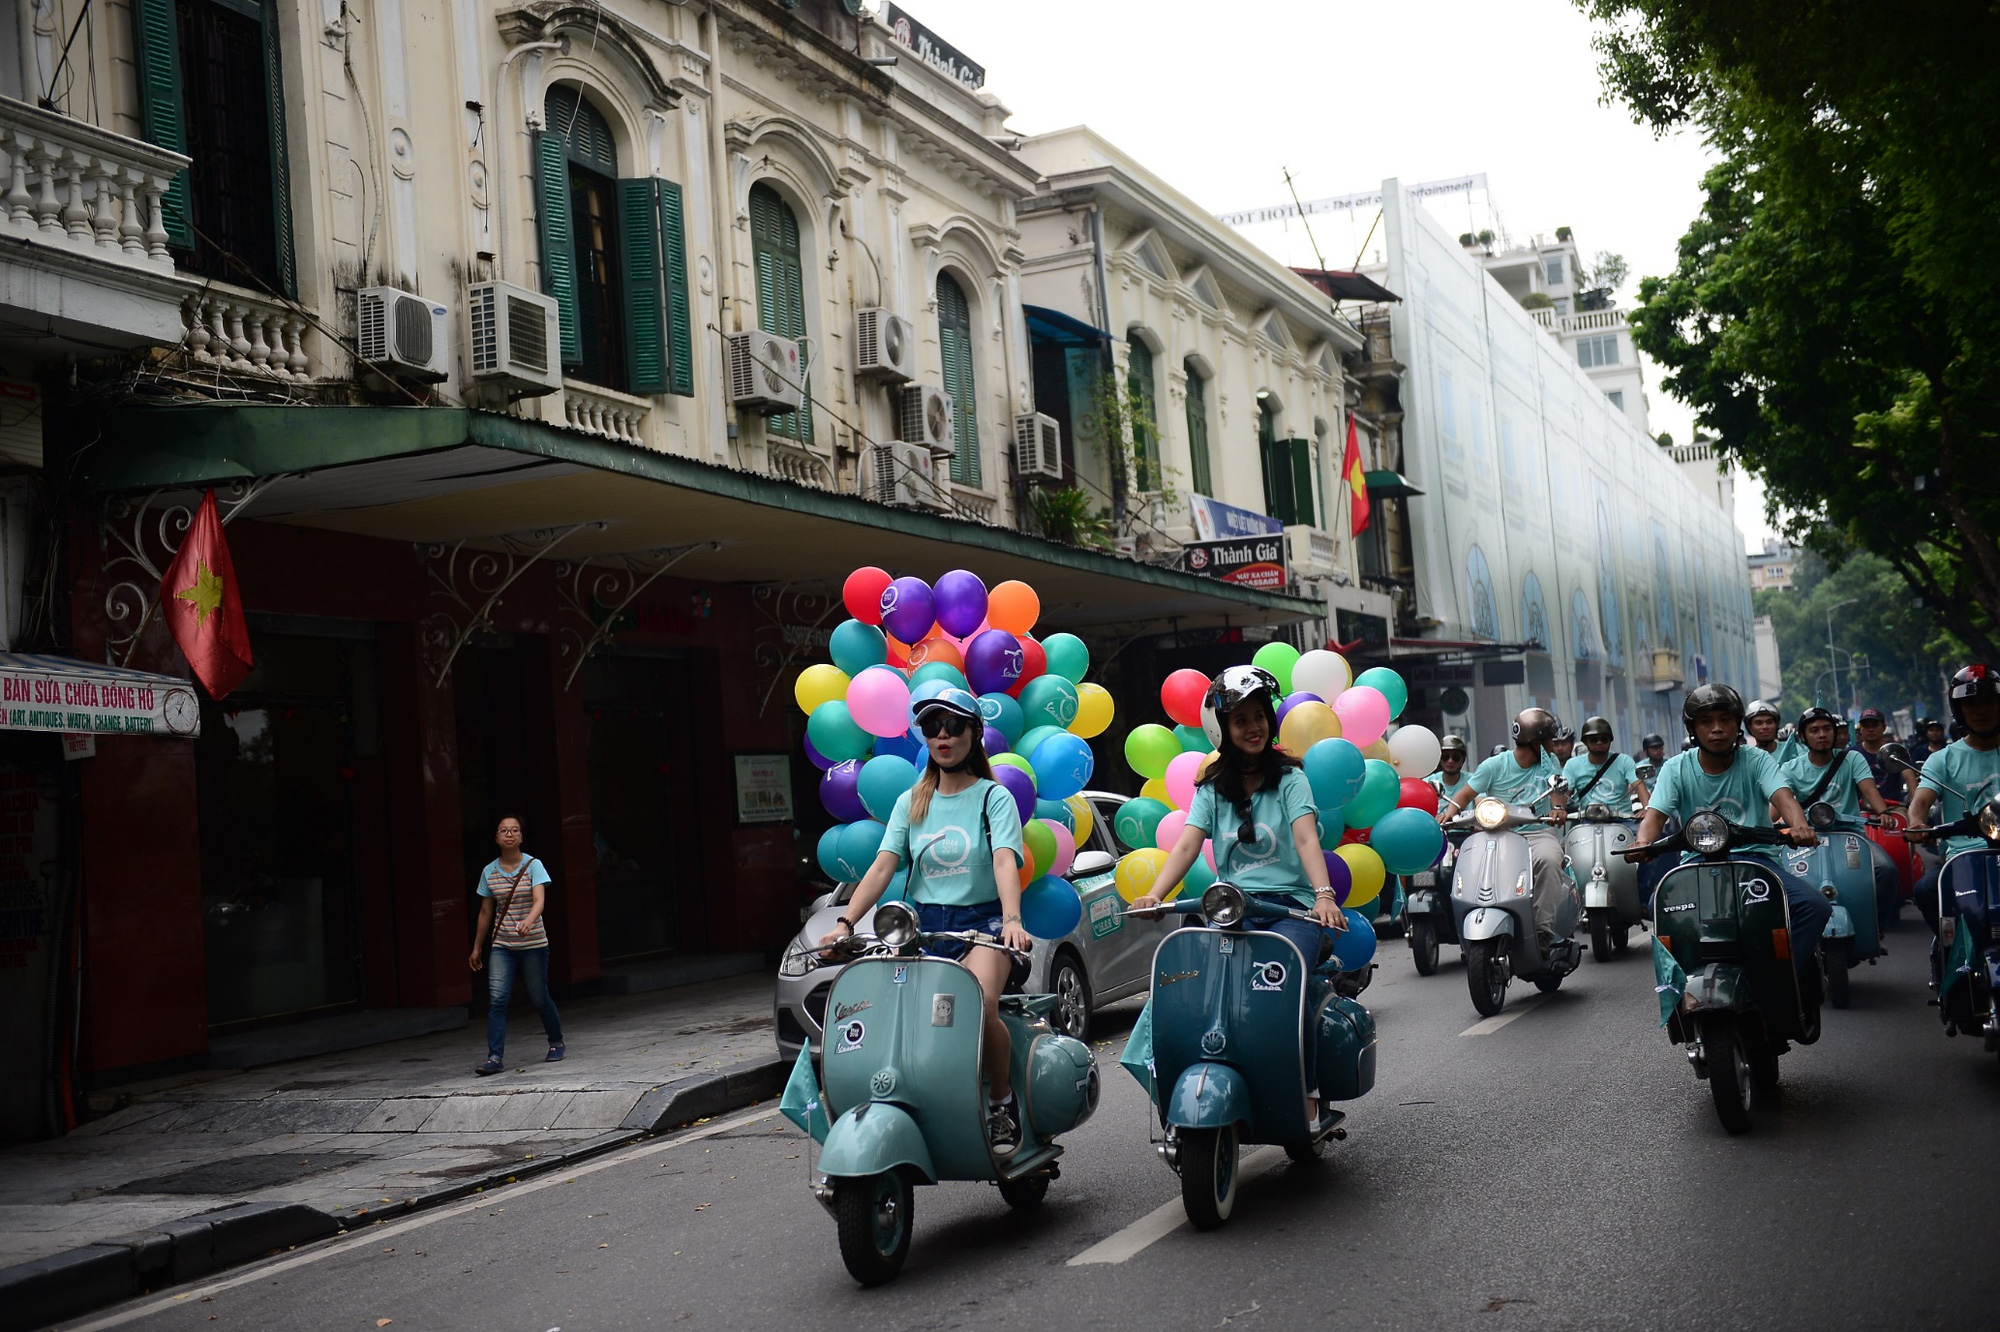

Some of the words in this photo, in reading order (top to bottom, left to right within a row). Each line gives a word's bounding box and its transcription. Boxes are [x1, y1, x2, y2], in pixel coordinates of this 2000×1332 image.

[1211, 545, 1253, 566] Thành
[1256, 543, 1278, 562] Gia
[4, 673, 31, 702] BÁN
[35, 674, 62, 705] SỬA
[65, 679, 99, 708] CHỮA
[9, 708, 27, 728] (ART,
[29, 710, 66, 730] ANTIQUES,
[67, 712, 93, 732] WATCH,
[94, 714, 124, 732] CHANGE,
[124, 715, 155, 733] BATTERY)
[917, 825, 972, 873] 70
[941, 846, 958, 854] 2016
[942, 838, 959, 847] 1946
[922, 863, 970, 880] Vespa
[1663, 902, 1697, 914] vespa
[1250, 961, 1287, 986] 70
[1252, 979, 1283, 992] Vespa
[836, 1020, 865, 1049] 70
[837, 1043, 863, 1054] Vespa
